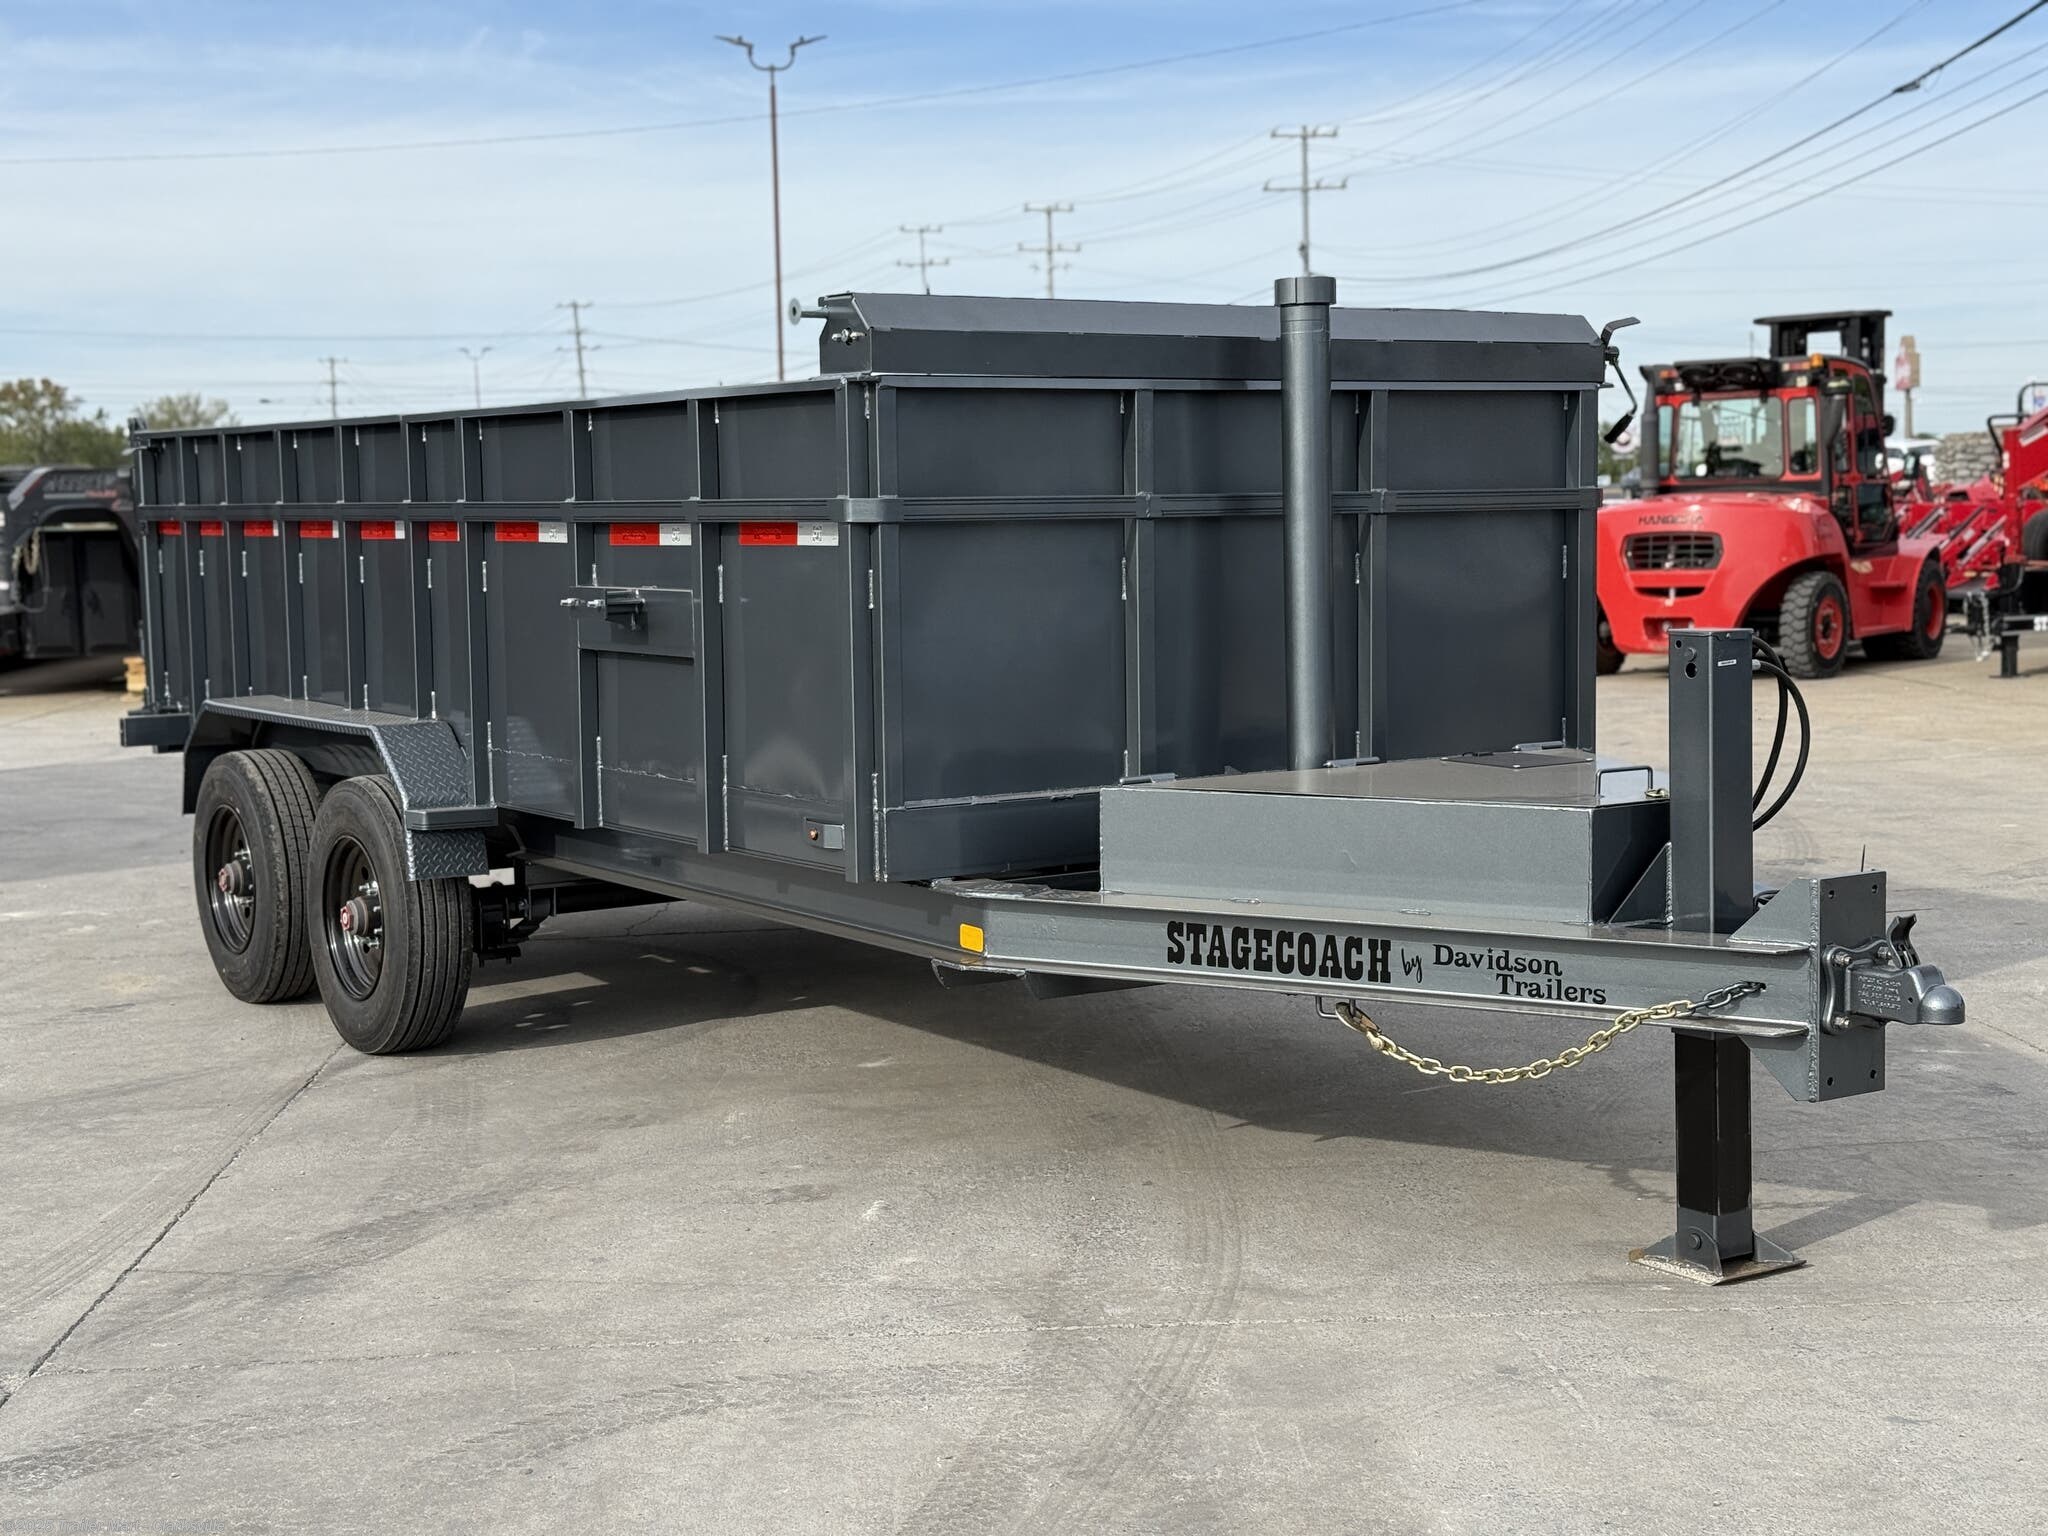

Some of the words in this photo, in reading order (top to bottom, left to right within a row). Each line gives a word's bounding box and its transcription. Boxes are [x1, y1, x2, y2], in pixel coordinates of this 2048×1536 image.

[1167, 921, 1391, 983] STAGECOACH
[1401, 948, 1423, 983] by
[1432, 944, 1562, 976] Davidson
[1496, 973, 1607, 1004] Trailers
